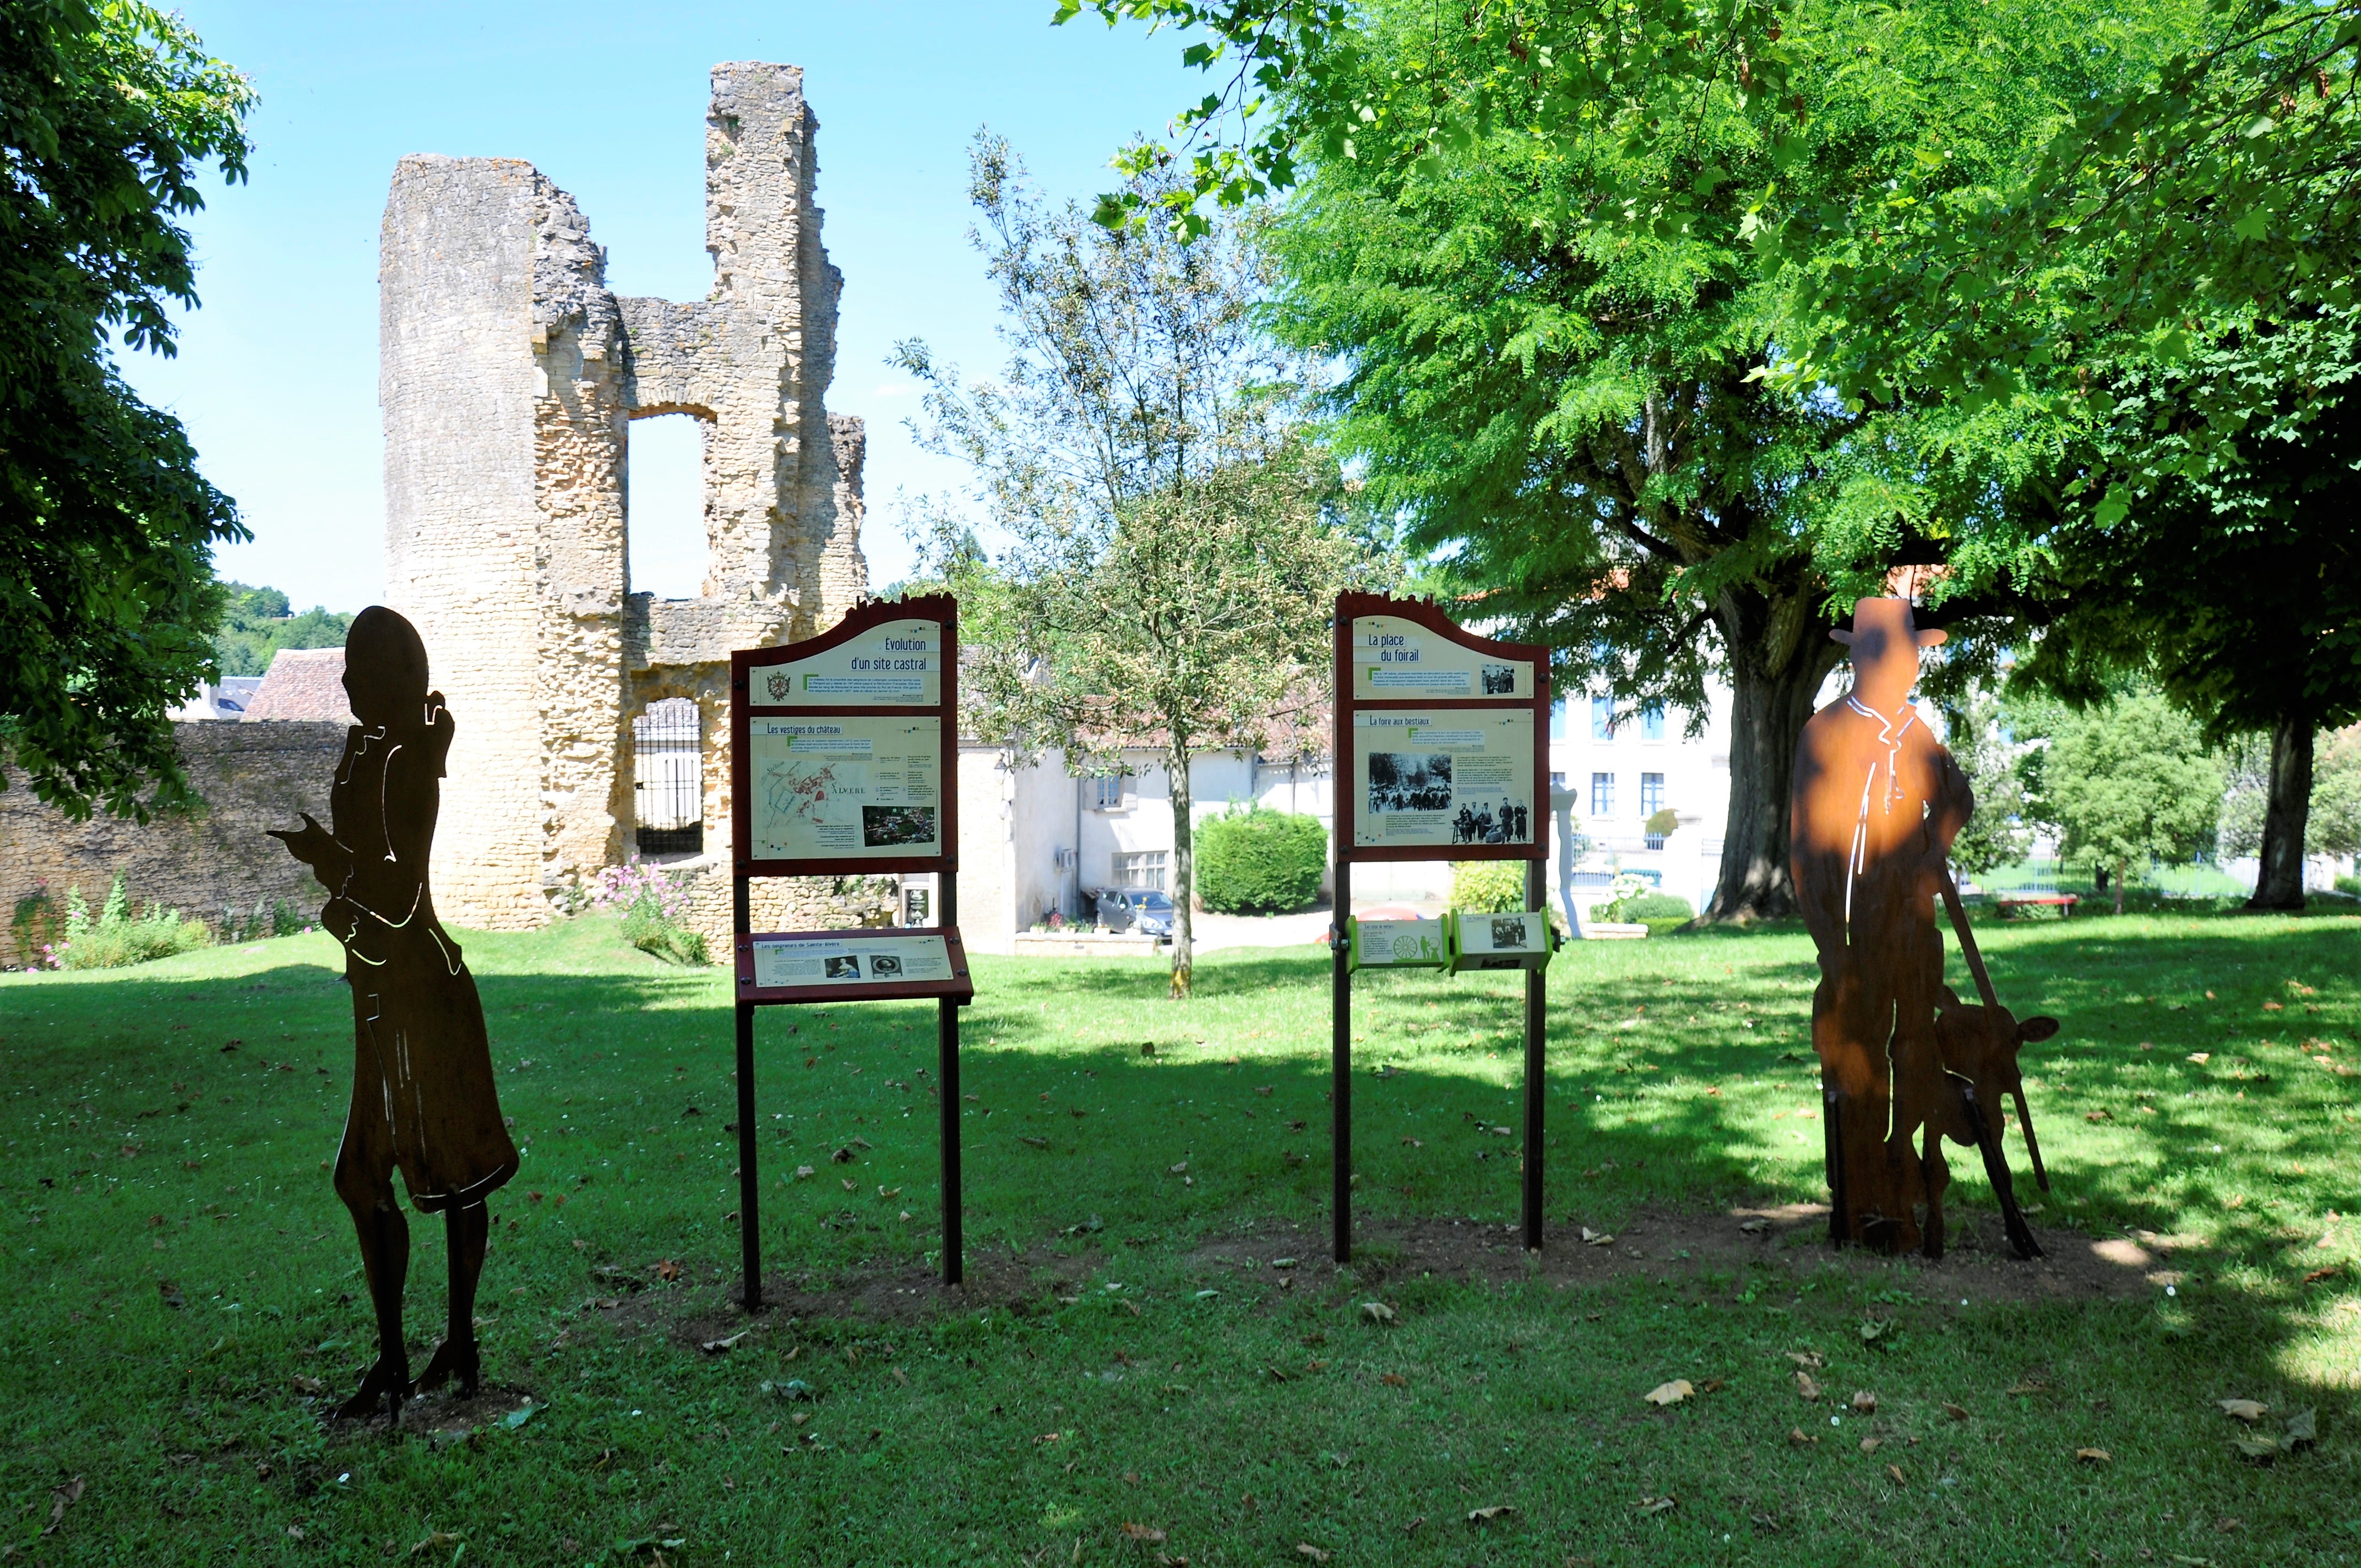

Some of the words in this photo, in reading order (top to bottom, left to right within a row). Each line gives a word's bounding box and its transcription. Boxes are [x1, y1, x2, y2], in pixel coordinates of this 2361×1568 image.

[885, 636, 926, 651] Évolution
[1369, 634, 1378, 646] La
[1381, 633, 1404, 647] place
[1381, 649, 1391, 661] du
[1395, 649, 1419, 661] foirail
[851, 657, 870, 669] d'un
[873, 657, 891, 670] site
[894, 657, 926, 670] castral
[1370, 715, 1377, 725] La
[768, 722, 778, 734] Les
[780, 726, 806, 735] vestiges
[807, 726, 815, 734] du
[817, 726, 840, 734] château
